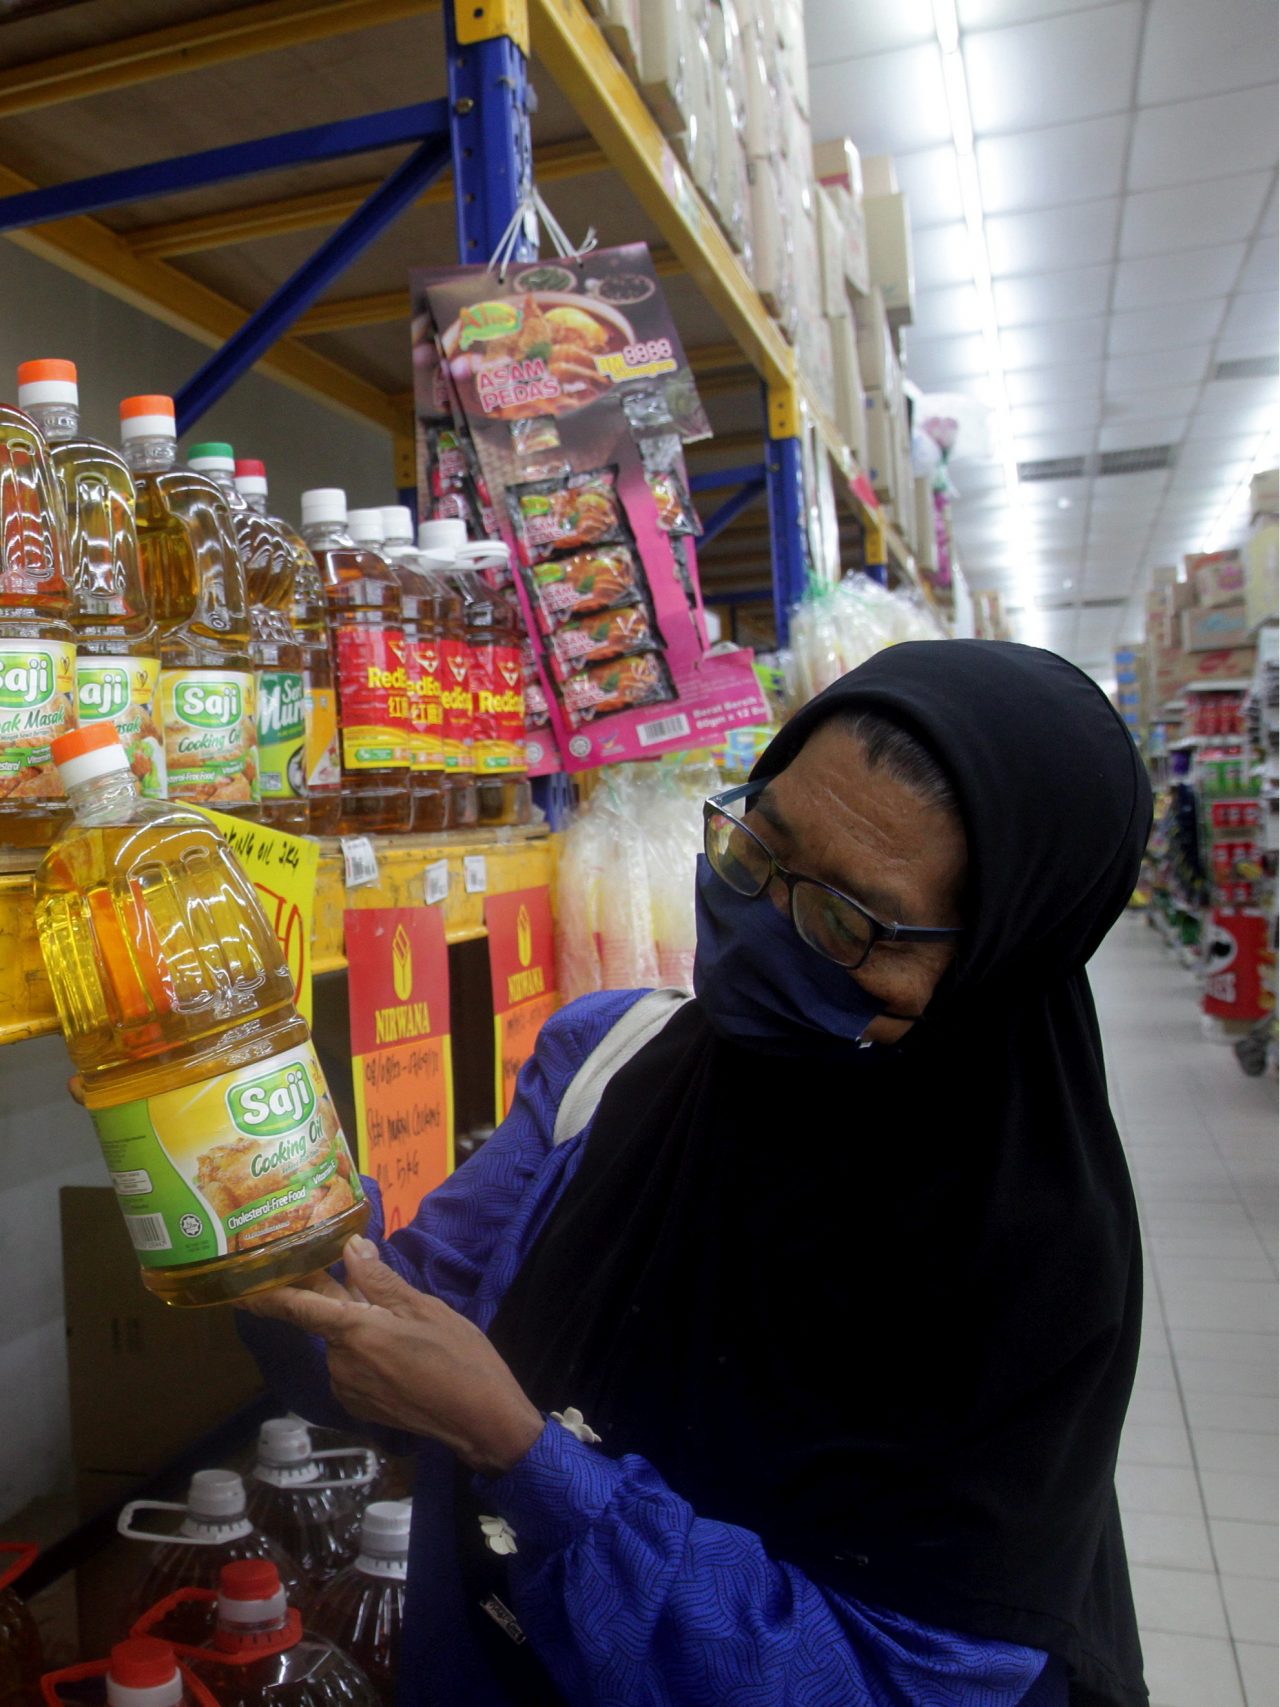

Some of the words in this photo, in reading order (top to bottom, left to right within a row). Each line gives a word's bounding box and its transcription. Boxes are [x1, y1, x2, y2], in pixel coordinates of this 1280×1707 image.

[479, 358, 545, 390] ASAM
[482, 377, 559, 412] PEDAS
[80, 674, 122, 714] aji
[183, 687, 238, 724] Saji
[24, 704, 66, 730] Masak
[178, 733, 225, 753] Cooking
[375, 1002, 432, 1044] NIRWANA
[239, 1070, 311, 1125] Saji
[251, 1135, 306, 1178] Cooking
[308, 1115, 324, 1144] Oil
[228, 1195, 289, 1230] Cholesterol-Free
[288, 1185, 306, 1203] Food
